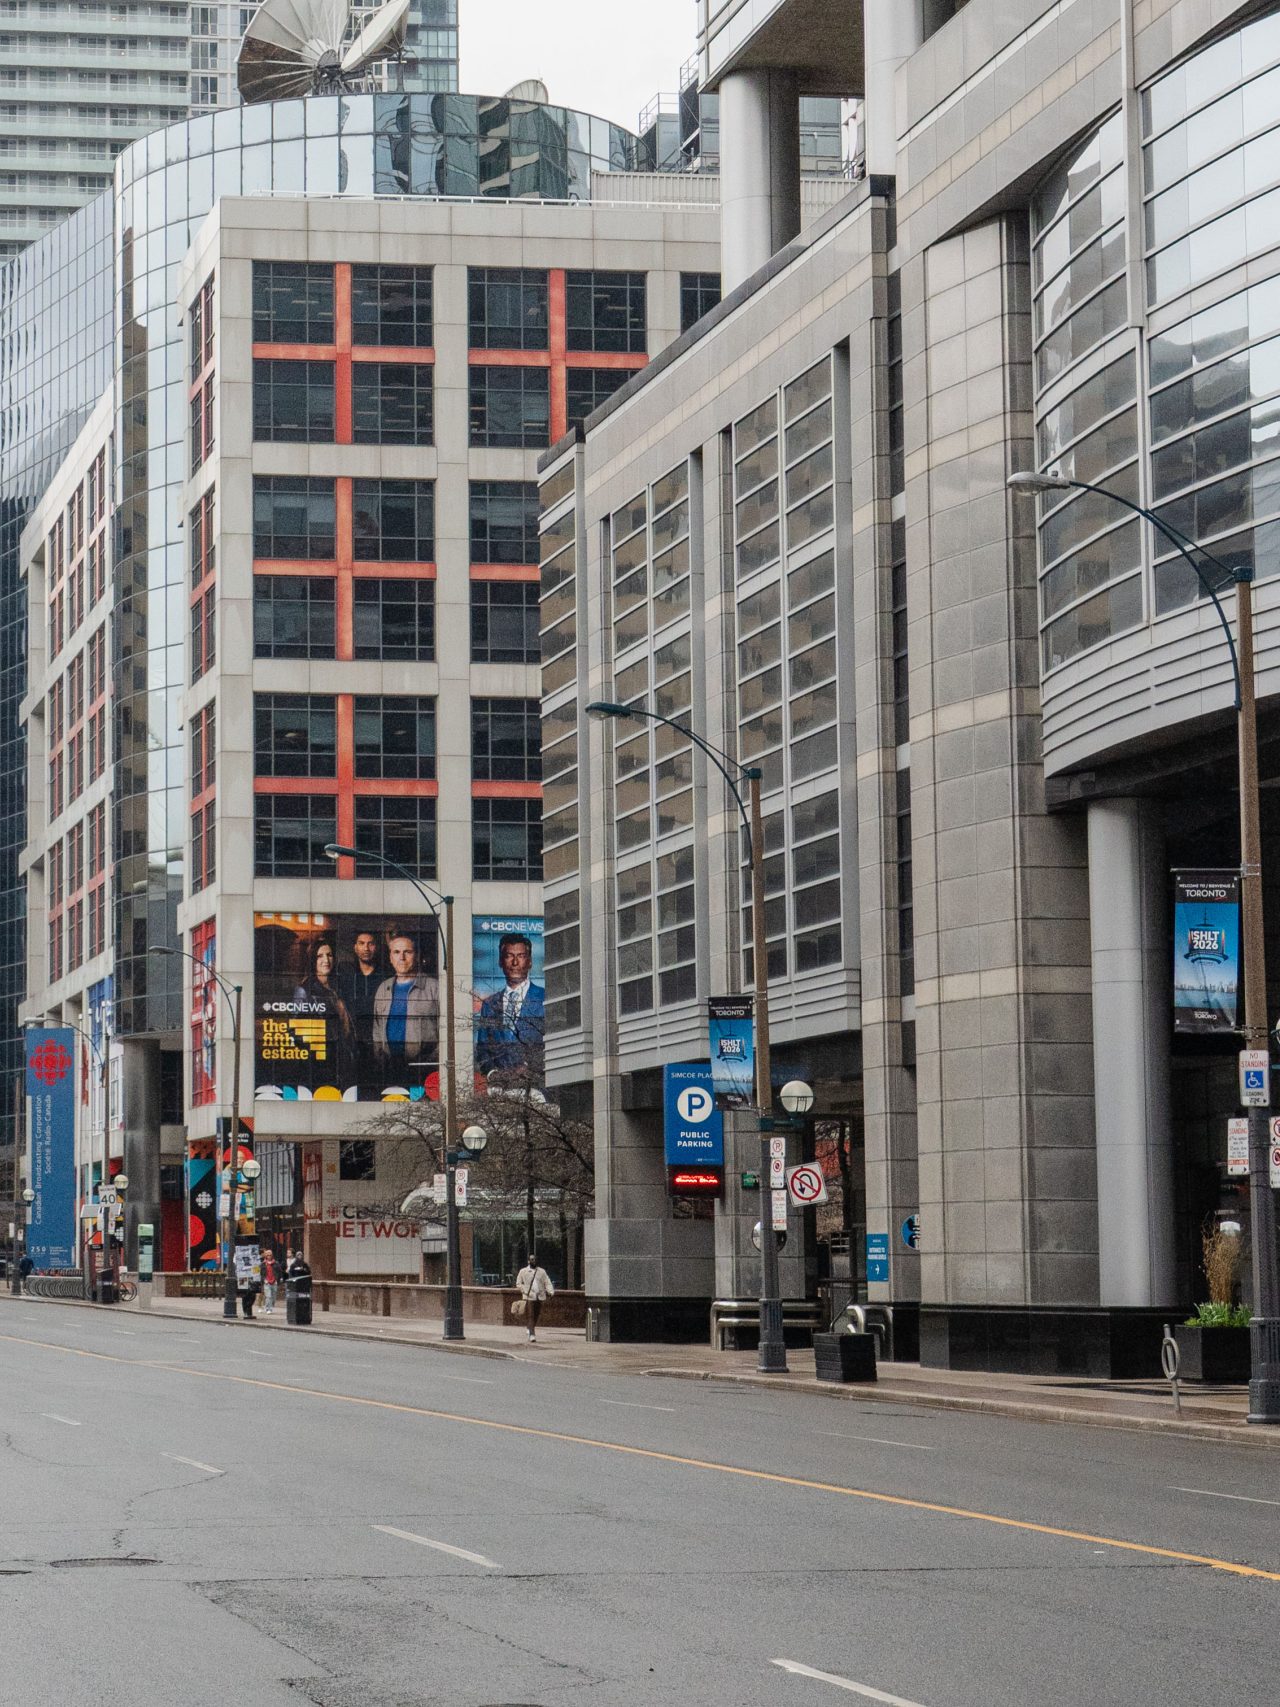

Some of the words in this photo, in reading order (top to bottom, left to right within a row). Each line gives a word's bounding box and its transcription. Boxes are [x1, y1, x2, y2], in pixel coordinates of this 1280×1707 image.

[1185, 889, 1227, 897] TORONTO
[1191, 930, 1220, 941] ISHLT
[1193, 940, 1219, 950] 2026
[262, 1018, 288, 1033] the
[262, 1032, 296, 1047] fifth
[262, 1047, 309, 1060] estate
[1240, 1060, 1268, 1068] STANDING
[687, 1093, 706, 1117] P
[680, 1131, 710, 1139] PUBLIC
[101, 1194, 116, 1204] 40
